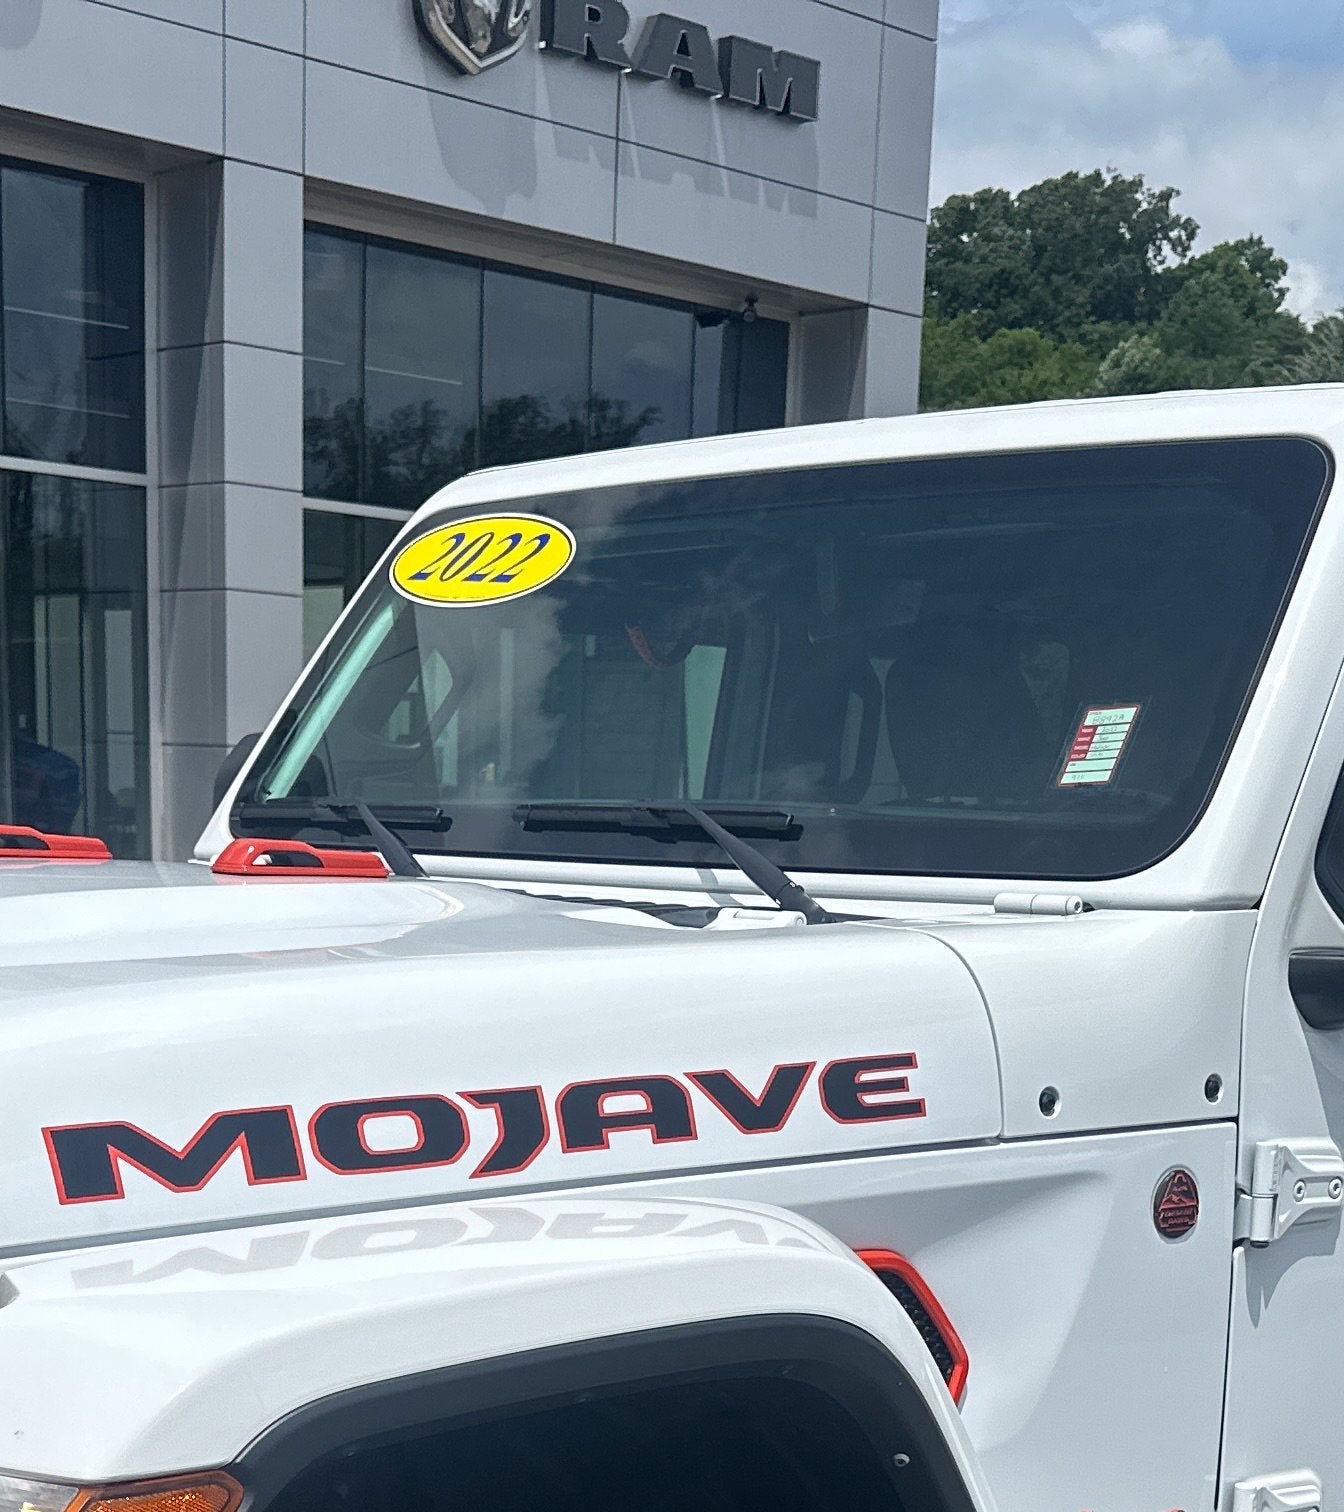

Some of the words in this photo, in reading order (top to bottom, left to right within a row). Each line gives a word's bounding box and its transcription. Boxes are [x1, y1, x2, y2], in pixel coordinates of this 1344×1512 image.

[540, 0, 821, 122] RAM
[407, 532, 551, 583] 2022
[43, 1053, 927, 1205] MOJAVE
